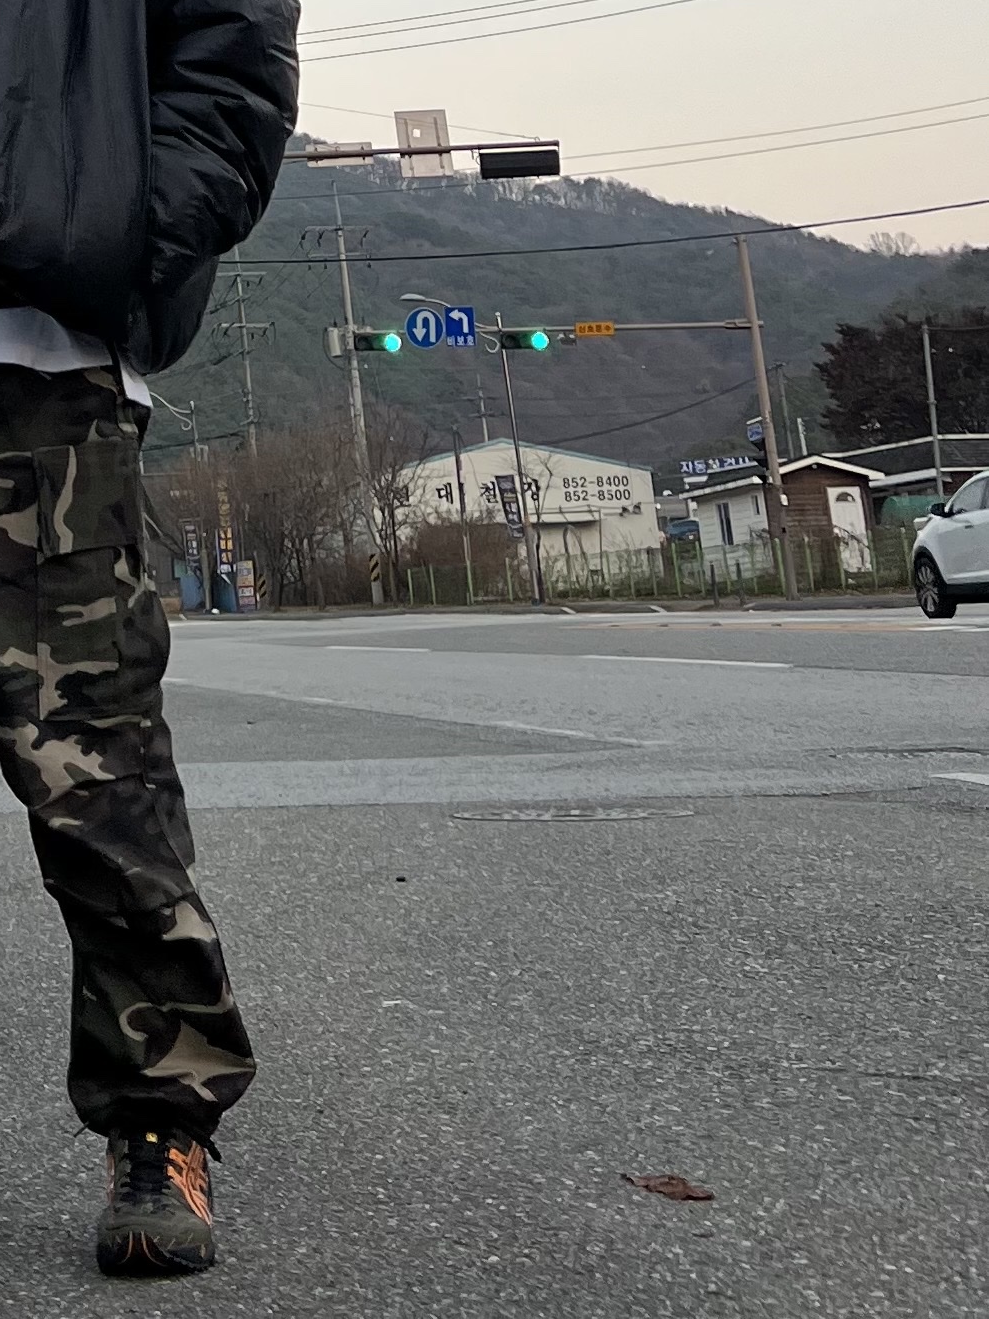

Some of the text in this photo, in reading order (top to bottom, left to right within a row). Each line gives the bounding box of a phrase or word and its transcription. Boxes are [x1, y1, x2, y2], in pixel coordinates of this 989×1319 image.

[447, 335, 475, 346] 비보호
[562, 475, 629, 489] 852-8400
[564, 489, 631, 502] 852-8500
